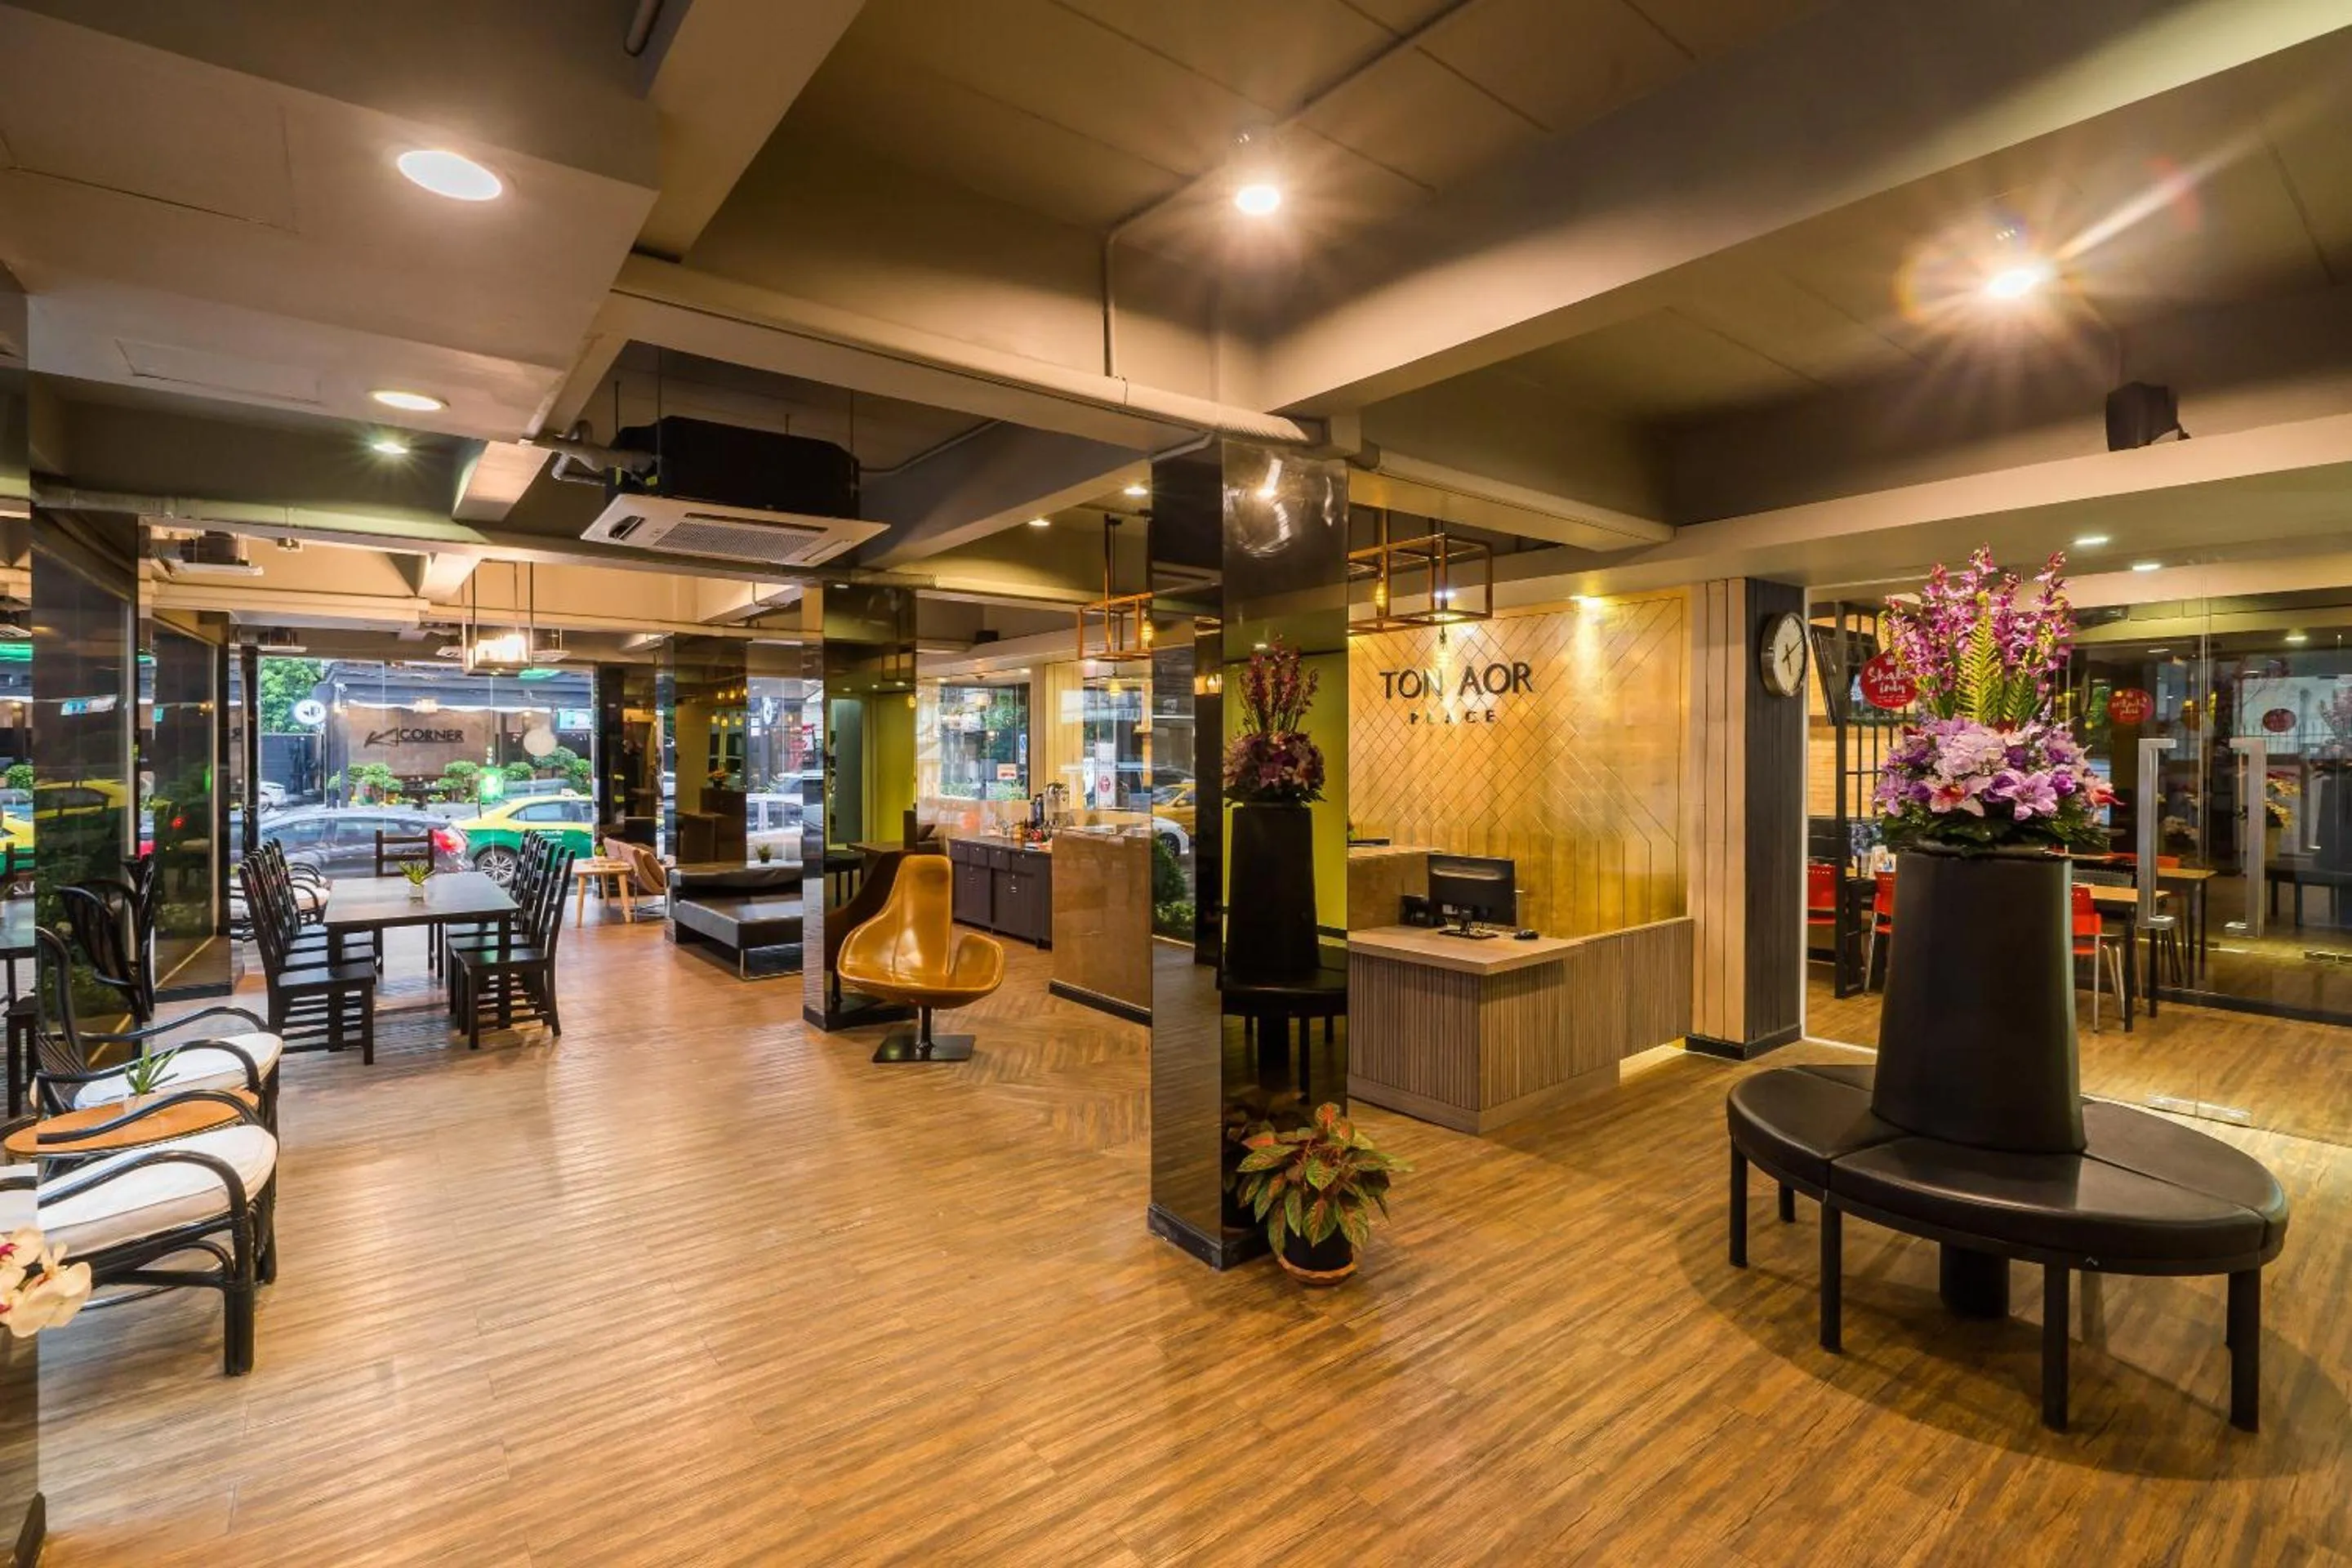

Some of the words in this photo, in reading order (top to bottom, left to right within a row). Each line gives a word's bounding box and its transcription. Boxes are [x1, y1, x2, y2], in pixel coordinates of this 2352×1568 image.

[1379, 668, 1443, 701] TON
[1458, 661, 1534, 696] AOR
[1410, 709, 1496, 725] PLACE
[399, 728, 465, 743] CORNER
